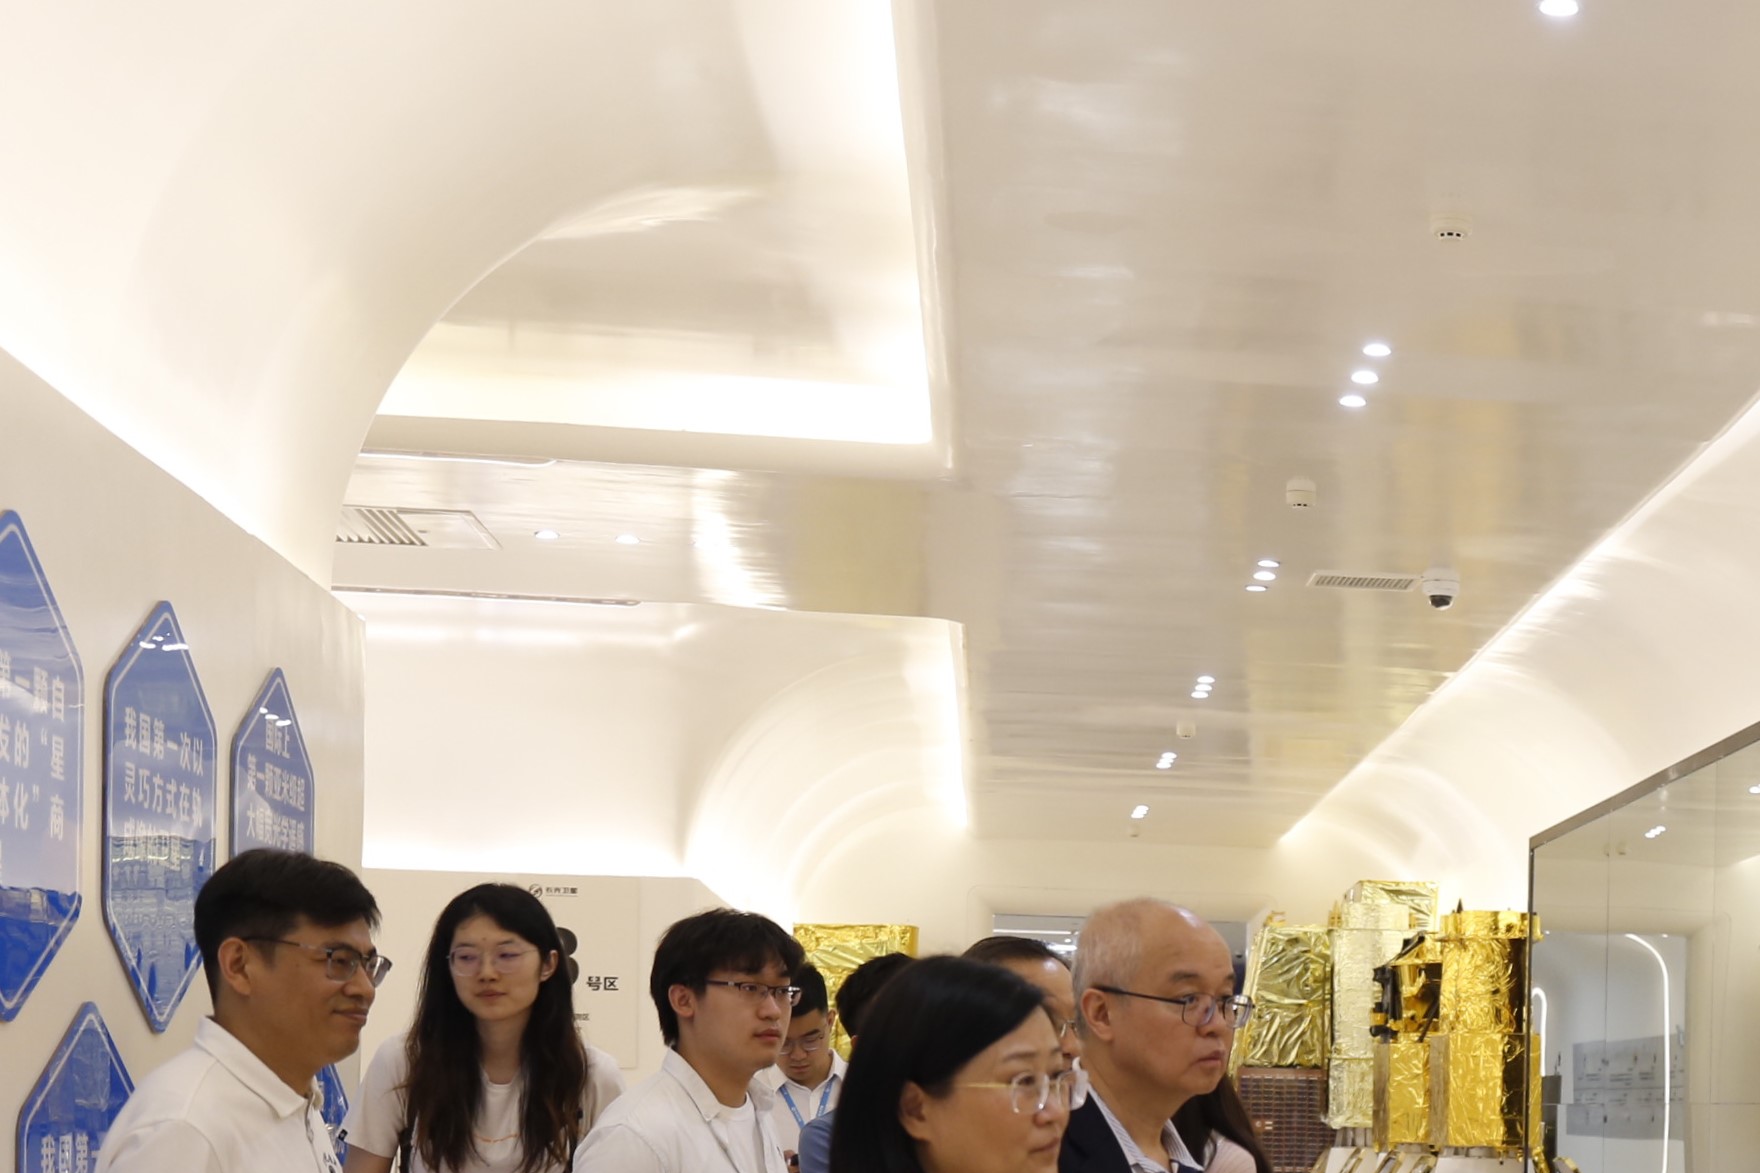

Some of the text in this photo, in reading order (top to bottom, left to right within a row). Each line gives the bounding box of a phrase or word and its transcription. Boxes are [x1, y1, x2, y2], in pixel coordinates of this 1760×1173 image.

[124, 706, 204, 777] 我国第一次以
[265, 719, 290, 759] 国际上
[124, 761, 203, 828] 灵巧方式在轨
